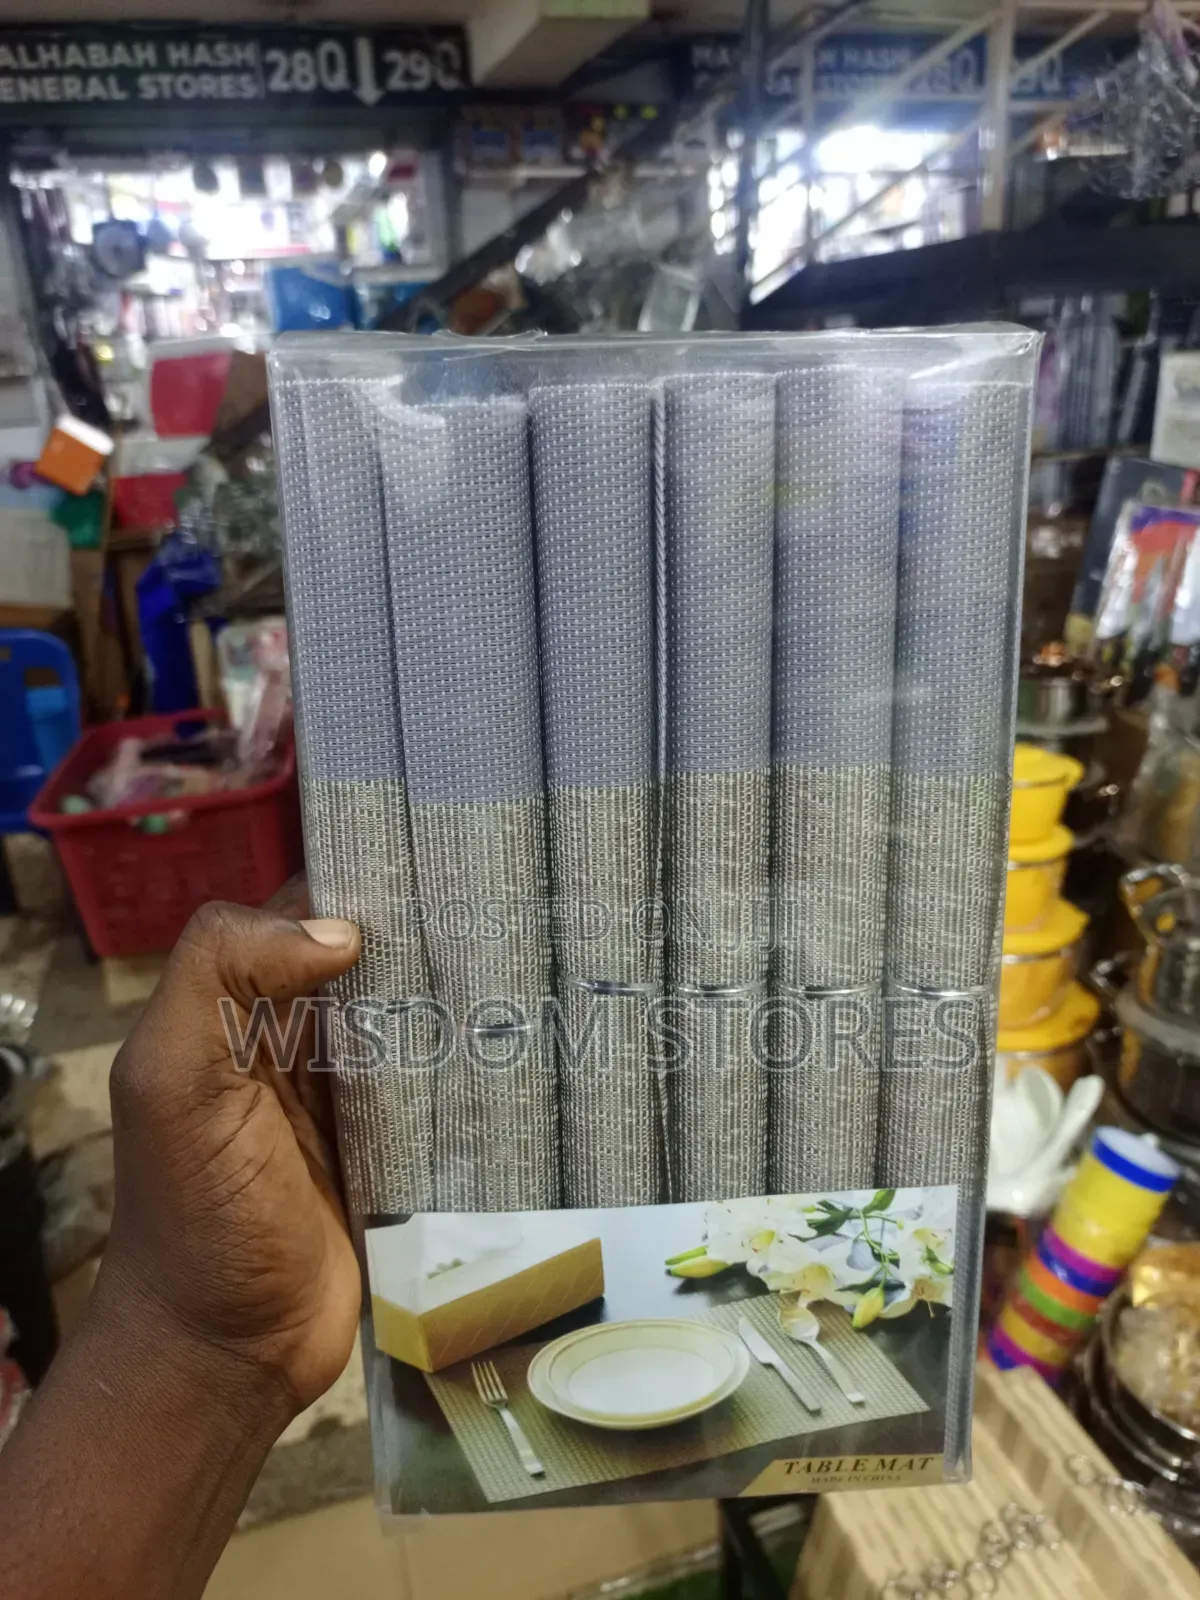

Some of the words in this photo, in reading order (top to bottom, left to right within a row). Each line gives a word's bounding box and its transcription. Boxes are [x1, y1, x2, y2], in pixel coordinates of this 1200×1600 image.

[165, 39, 258, 68] HASH
[136, 73, 259, 100] STORES
[784, 1458, 868, 1475] TABLE
[874, 1457, 934, 1472] MAT
[810, 1476, 843, 1484] MADE
[848, 1475, 861, 1483] IN
[862, 1474, 902, 1483] CHINA
